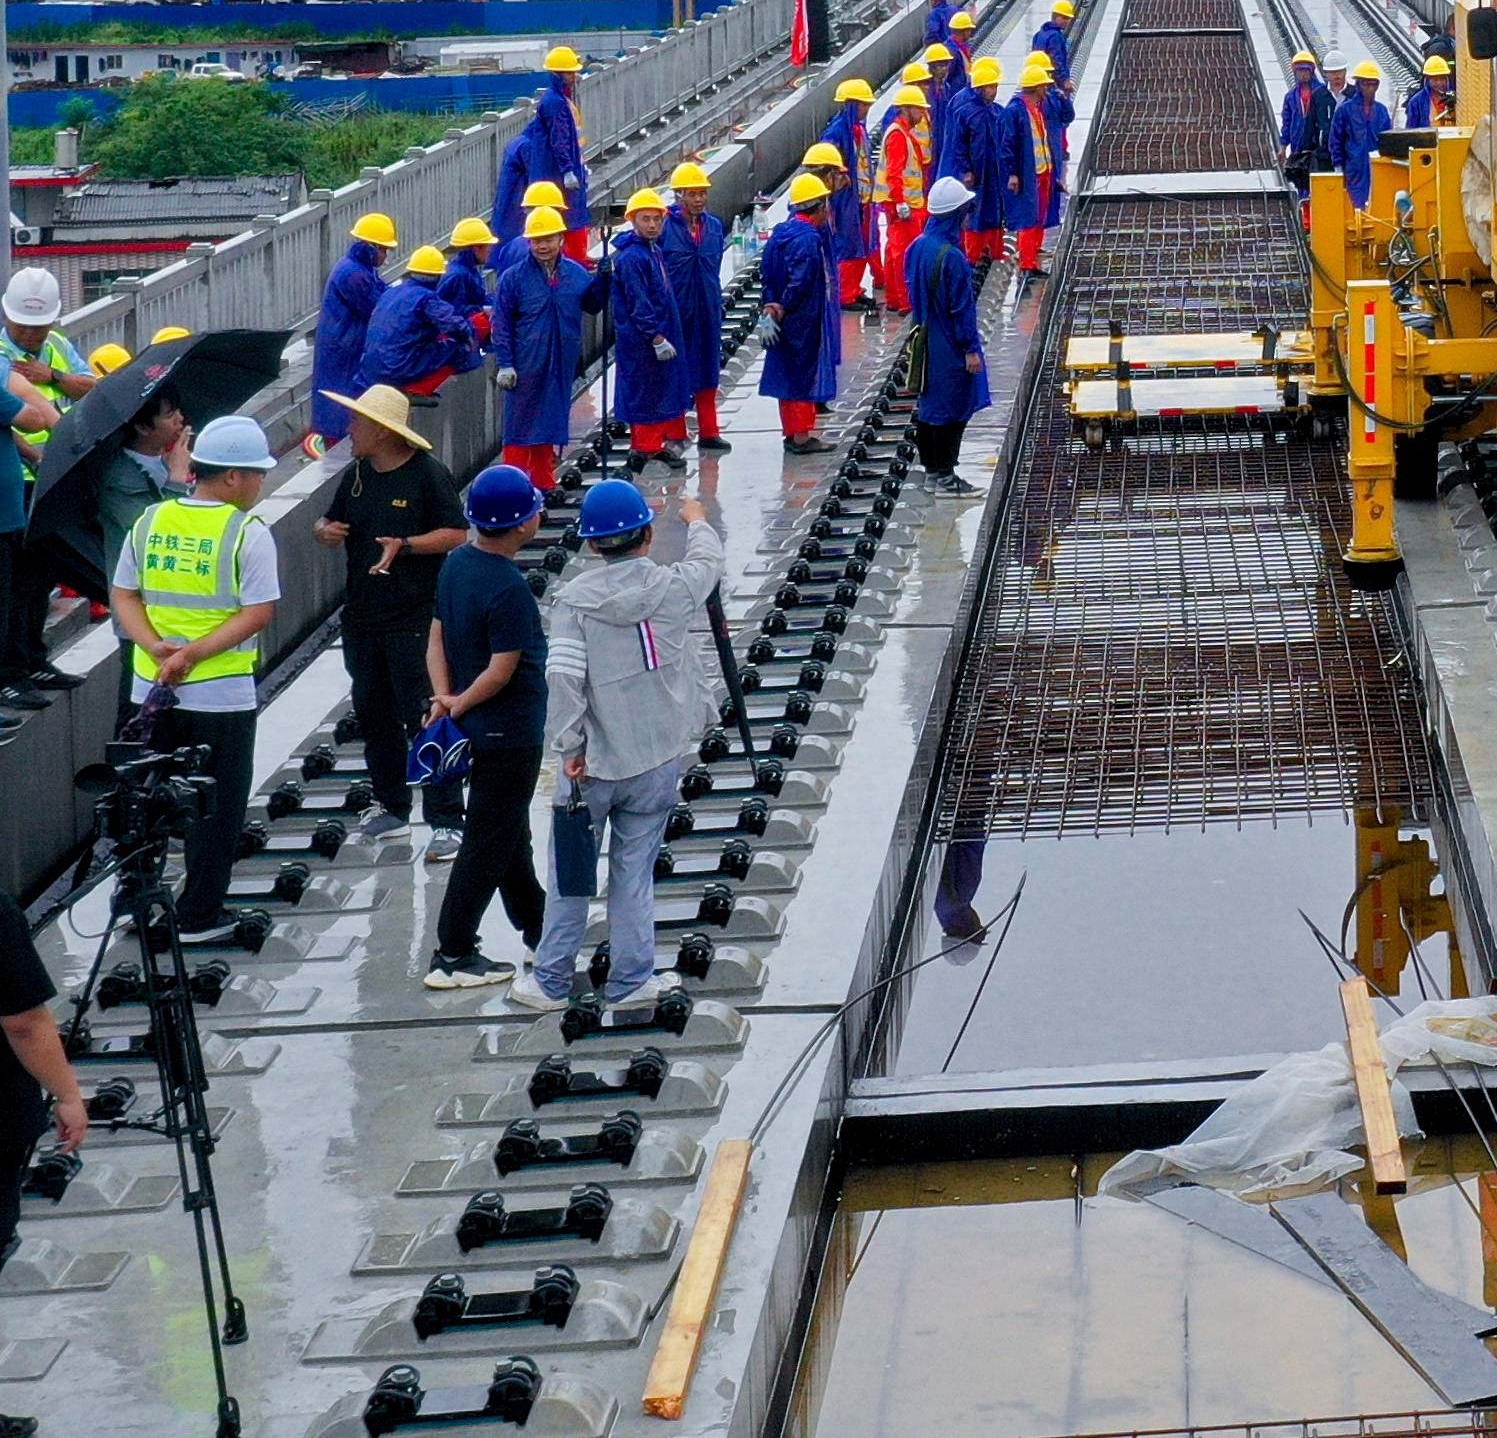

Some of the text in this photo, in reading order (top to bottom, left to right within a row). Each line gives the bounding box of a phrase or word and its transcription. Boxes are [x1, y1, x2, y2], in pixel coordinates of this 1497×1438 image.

[149, 533, 213, 555] 中铁三局
[147, 553, 210, 576] 黄黄二标
